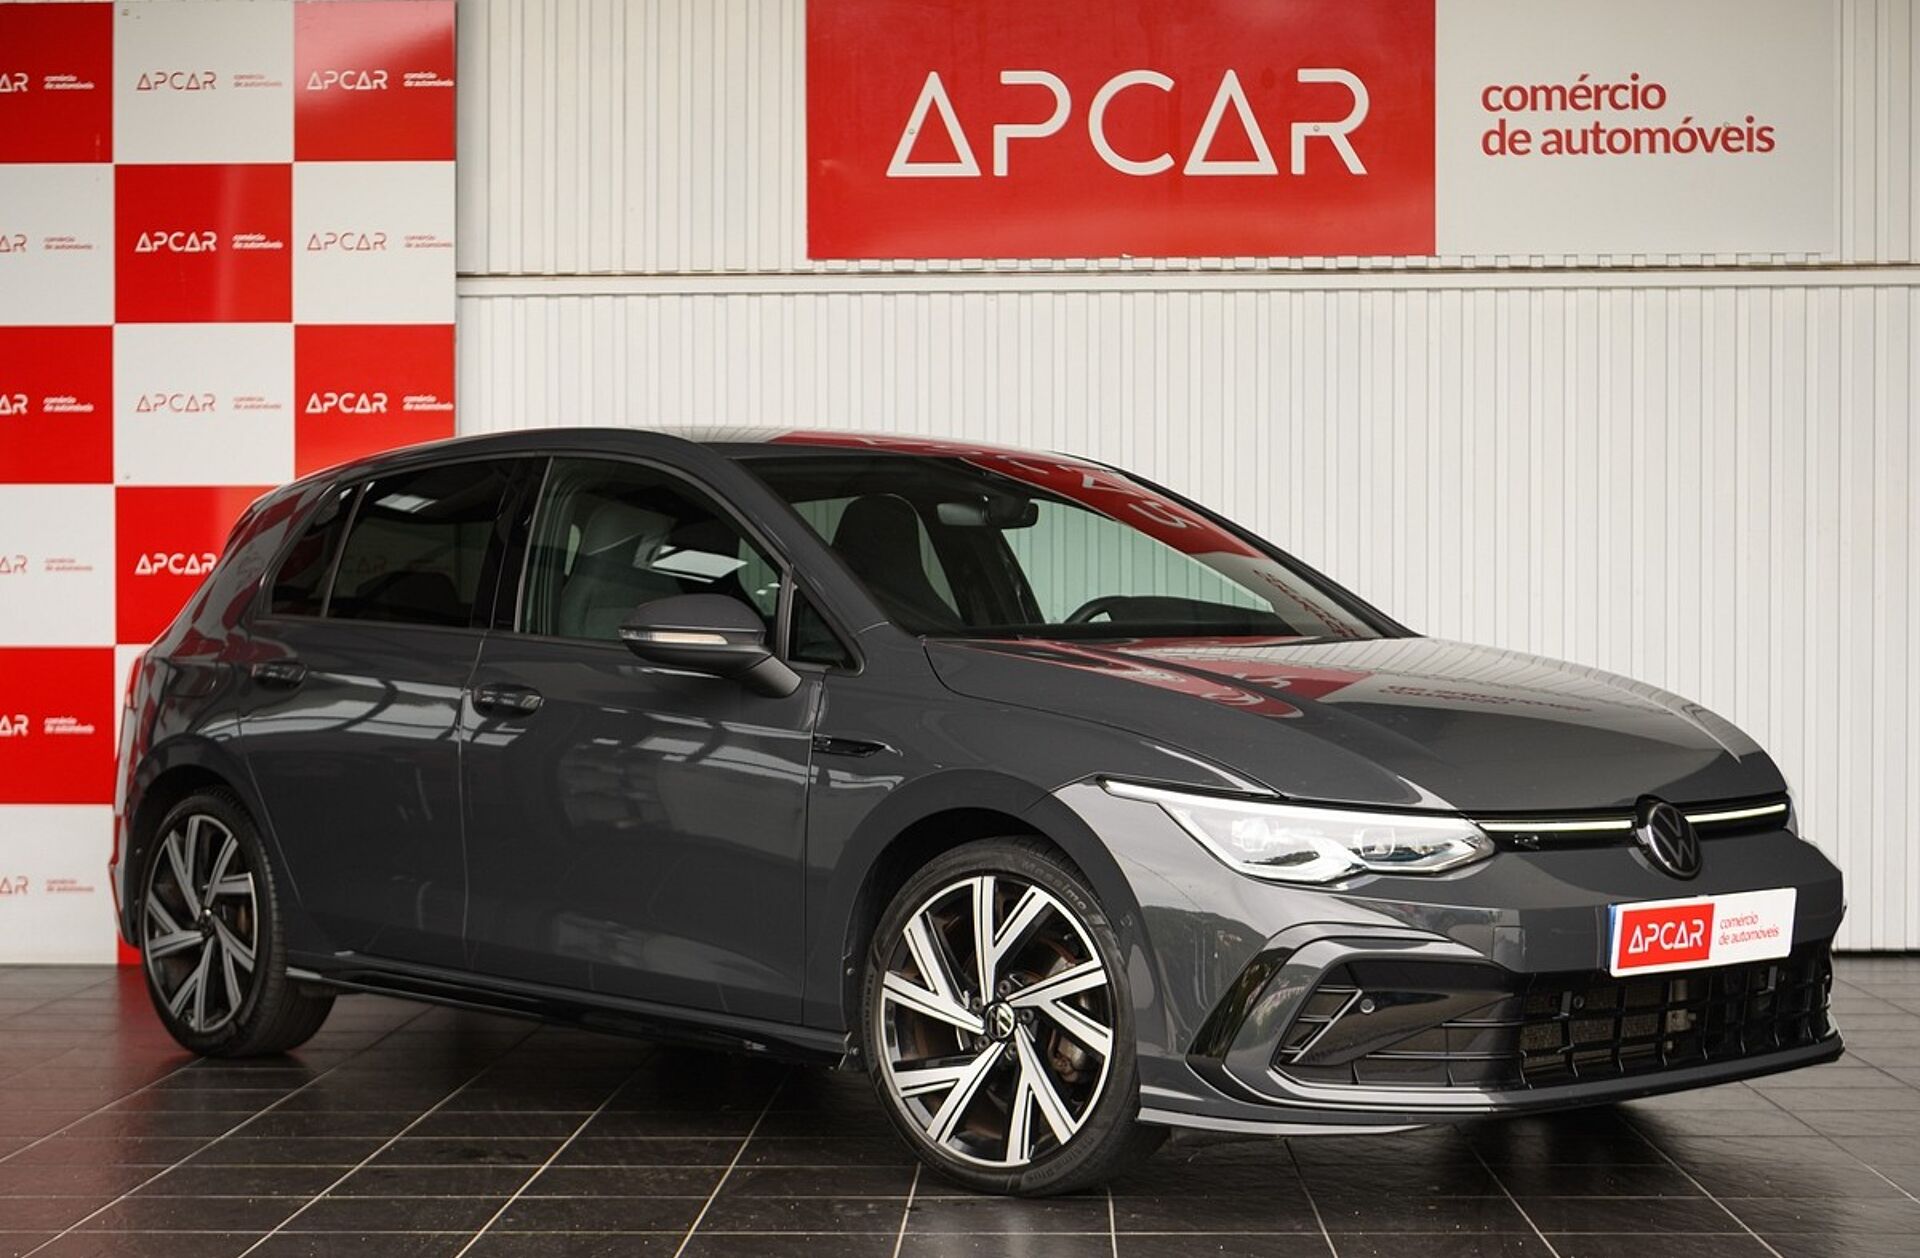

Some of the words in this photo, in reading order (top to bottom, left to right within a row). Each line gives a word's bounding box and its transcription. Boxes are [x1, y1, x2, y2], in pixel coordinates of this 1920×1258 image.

[136, 71, 217, 91] APCAR
[306, 70, 388, 91] APCAR
[1481, 72, 1667, 112] comércio
[886, 69, 1369, 178] APCAR
[1481, 118, 1532, 156] de
[1540, 115, 1776, 155] automóveis
[135, 231, 217, 252] APCAR
[307, 232, 387, 251] APCAR
[136, 393, 216, 413] APCAR
[305, 392, 388, 414] APCAR
[135, 552, 217, 575] APCAR
[1627, 918, 1705, 954] APCAR
